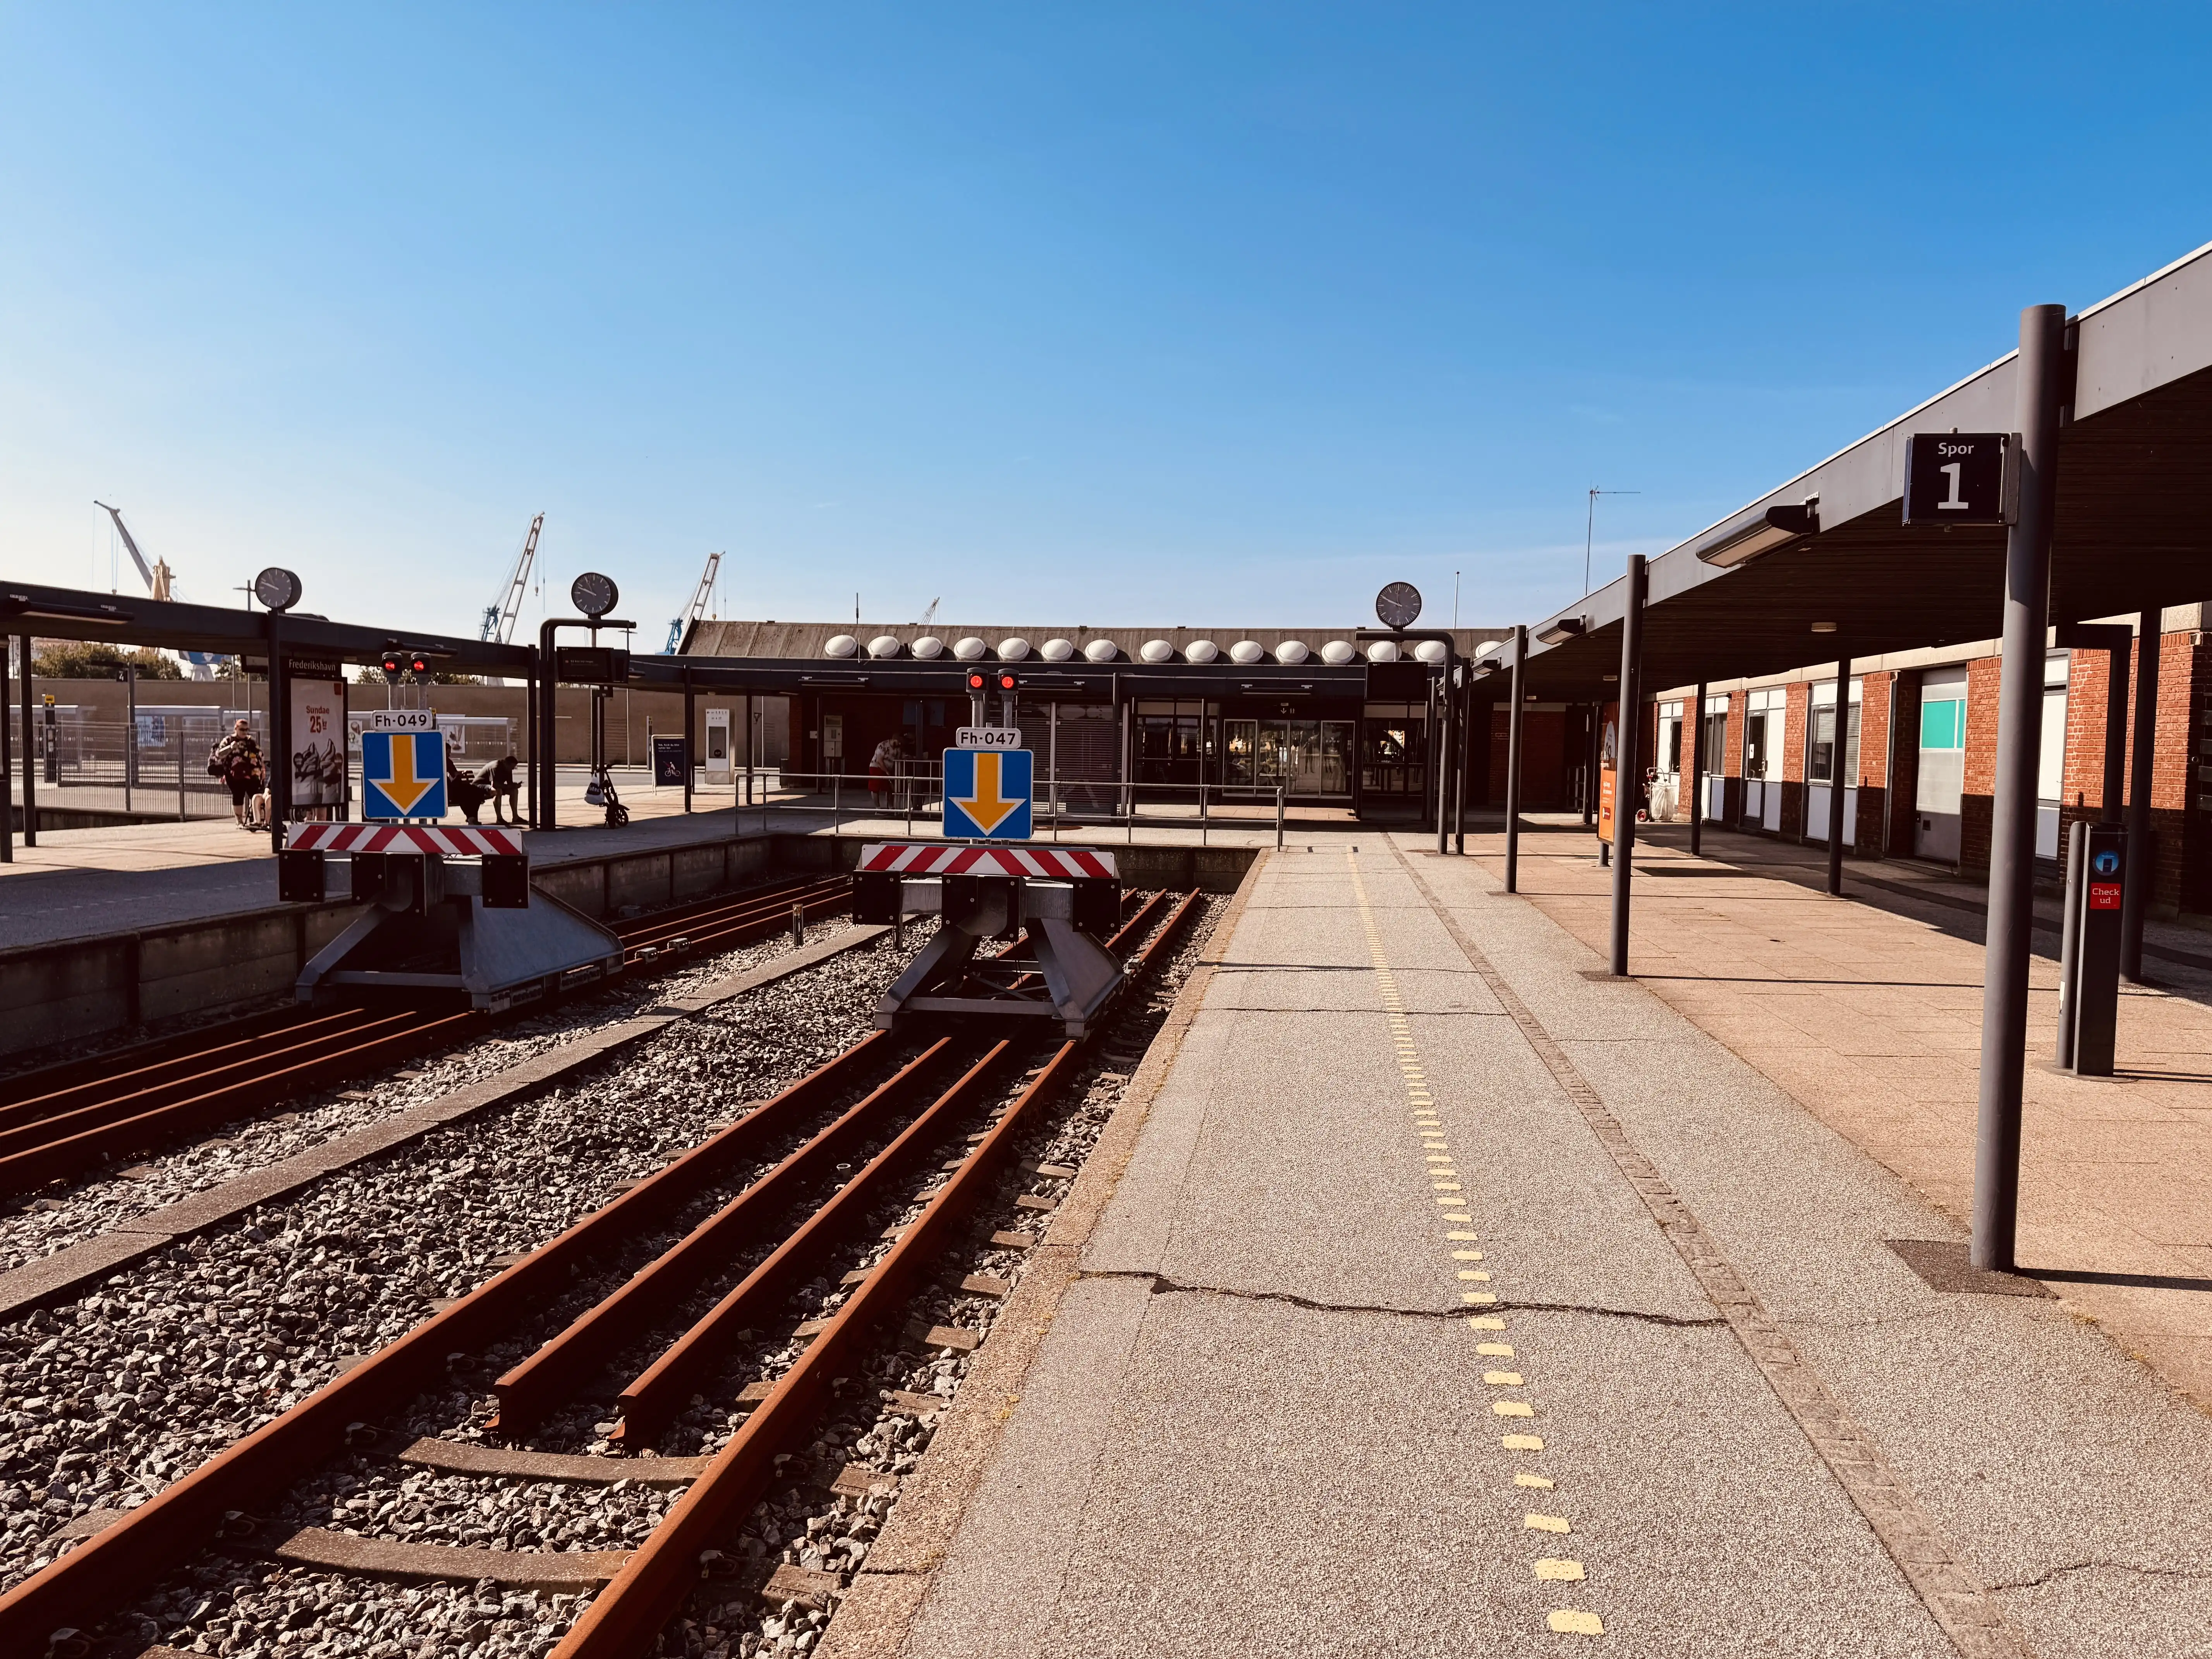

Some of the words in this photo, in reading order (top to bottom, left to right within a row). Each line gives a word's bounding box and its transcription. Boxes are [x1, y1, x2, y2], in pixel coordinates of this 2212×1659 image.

[1938, 442, 1974, 457] Spor
[1937, 463, 1969, 509] 1
[289, 659, 336, 671] Frederikshavn
[306, 705, 330, 714] Sundae
[310, 715, 321, 733] 25
[961, 732, 1015, 745] Fh-047
